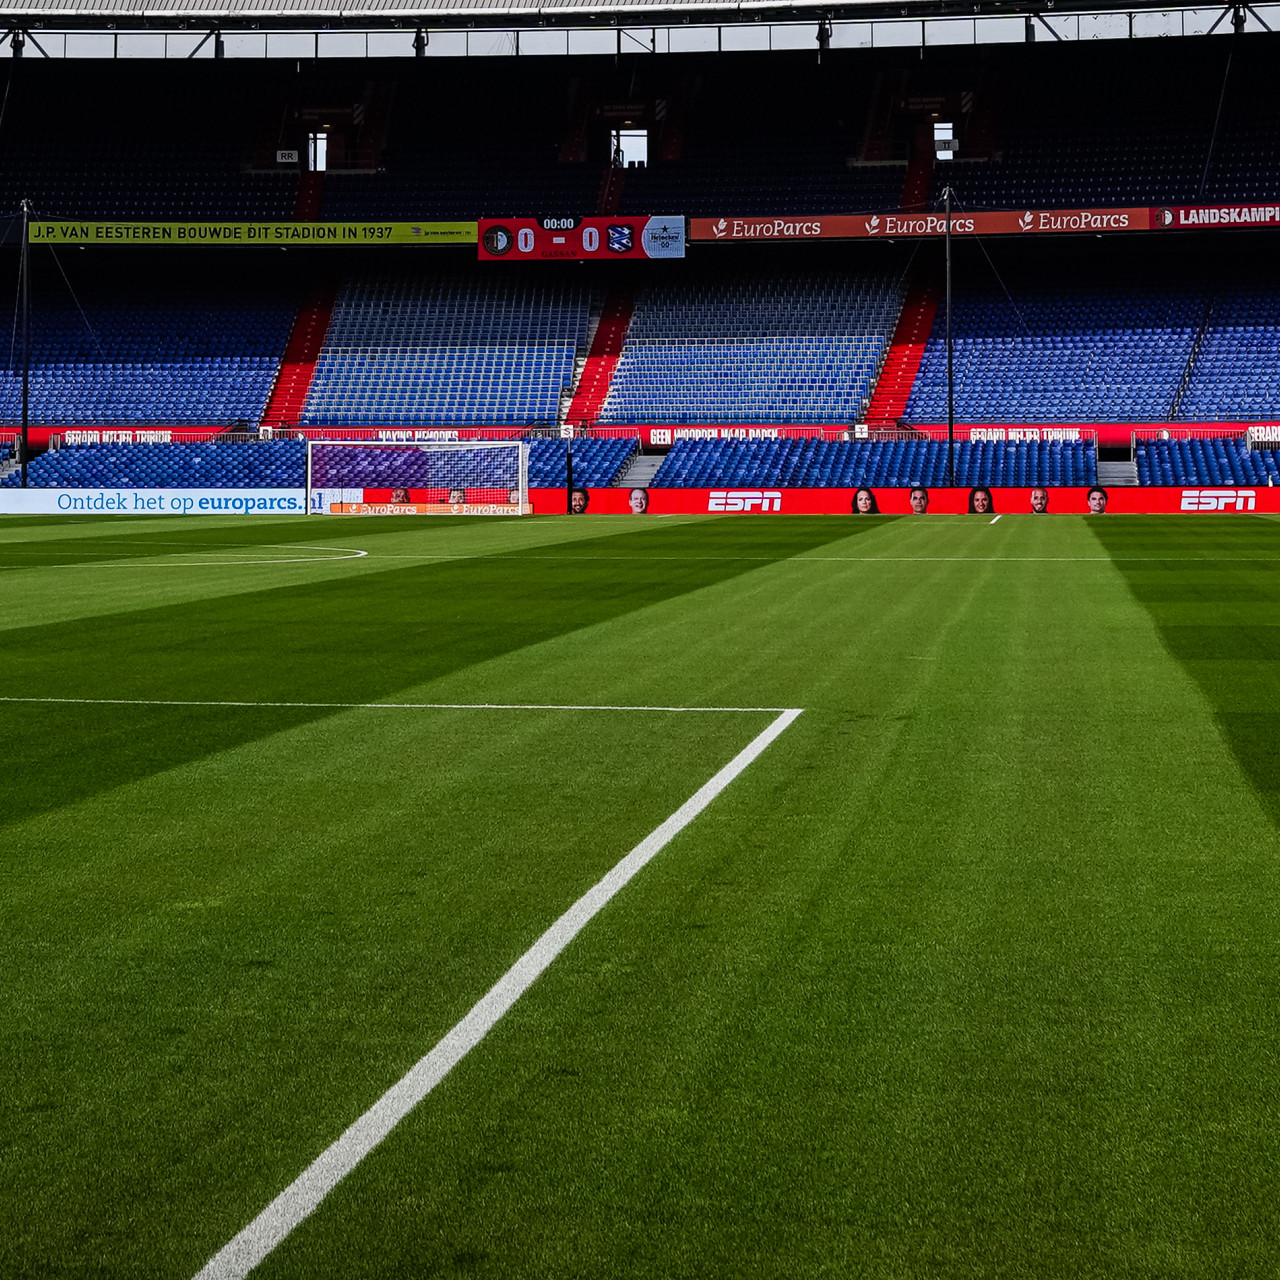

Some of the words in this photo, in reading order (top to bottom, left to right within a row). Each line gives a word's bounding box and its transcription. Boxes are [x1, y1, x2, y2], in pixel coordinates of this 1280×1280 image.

[543, 219, 574, 230] 00:00
[732, 220, 820, 237] EuroParcs
[885, 216, 974, 233] EuroParcs
[1039, 212, 1129, 230] EuroParcs
[34, 226, 56, 238] J.P.
[60, 226, 89, 238] VAN
[95, 226, 171, 238] EESTEREN
[177, 226, 242, 238] BOUWDE
[247, 227, 271, 238] DIT
[274, 227, 337, 239] STADION
[342, 227, 357, 238] IN
[361, 227, 392, 239] 1937
[518, 228, 535, 253] 0
[583, 227, 600, 252] 0
[650, 428, 671, 444] GEEN
[58, 493, 127, 510] Ontdek
[134, 493, 166, 510] het
[170, 497, 194, 514] op
[708, 491, 782, 511] ESPN
[1180, 490, 1256, 510] ESPN
[361, 504, 417, 515] EuroParcs
[463, 504, 520, 515] EuroParcs
